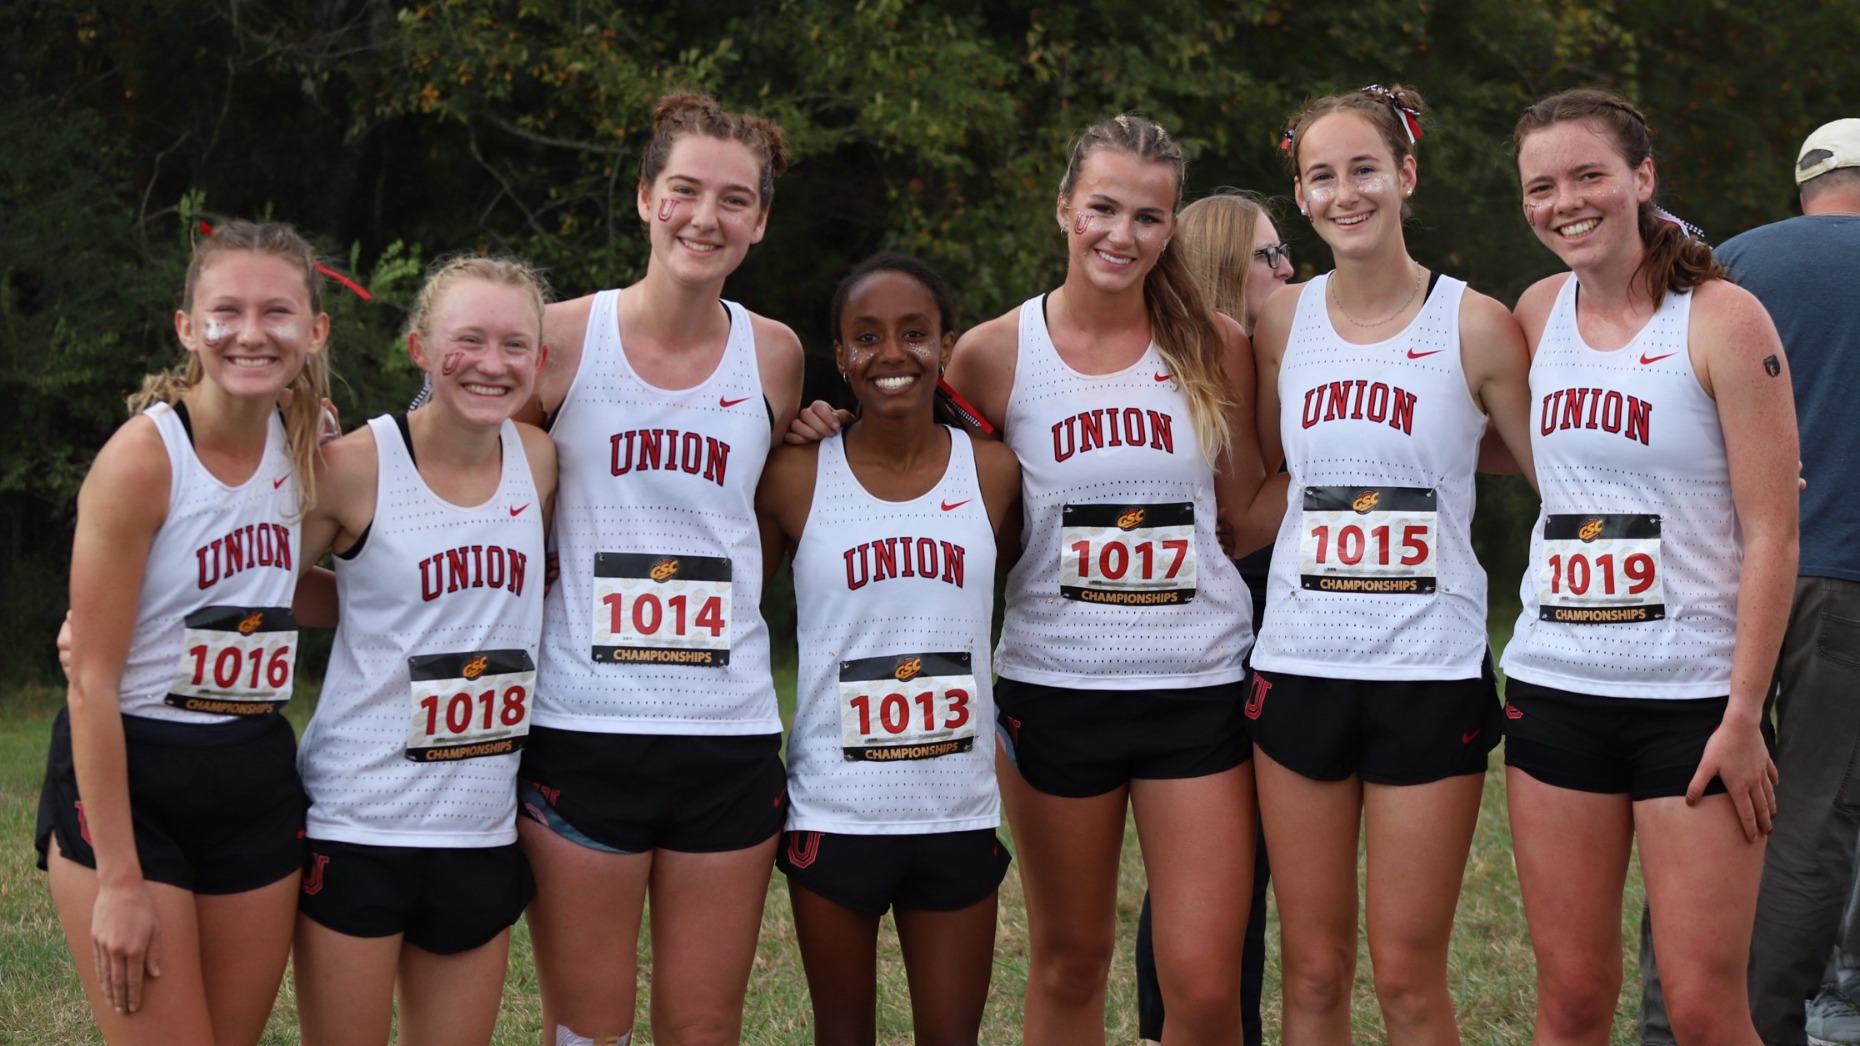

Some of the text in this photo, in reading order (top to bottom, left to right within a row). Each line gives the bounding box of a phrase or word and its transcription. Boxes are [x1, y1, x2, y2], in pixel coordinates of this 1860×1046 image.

[1301, 379, 1418, 436] UNION
[1540, 388, 1652, 446] UNION
[1051, 407, 1173, 463] UNION
[610, 428, 730, 487] UNION
[1117, 509, 1144, 528] GSC
[1352, 491, 1380, 511] GSC
[1311, 525, 1429, 566] 1015
[1579, 520, 1603, 540] GSC
[197, 523, 291, 590] UNION
[419, 545, 527, 601] UNION
[650, 559, 679, 581] GSC
[844, 537, 965, 591] UNION
[1071, 539, 1189, 580] 1017
[1548, 553, 1656, 595] 1019
[1081, 590, 1178, 604] CHAMPIONSHIPS
[1319, 579, 1418, 592] CHAMPIONSHIPS
[602, 592, 725, 637] 1014
[1555, 608, 1646, 621] CHAMPIONSHIPS
[189, 645, 290, 689] 1016
[462, 656, 487, 677] GSC
[613, 648, 712, 664] CHAMPIONSHIPS
[895, 658, 920, 679] GSC
[185, 699, 274, 714] CHAMPIONSHIPS
[420, 685, 526, 735] 1018
[849, 688, 970, 736] 1013
[425, 739, 513, 761] CHAMPIONSHIPS
[864, 741, 959, 761] CHAMPIONSHIPS
